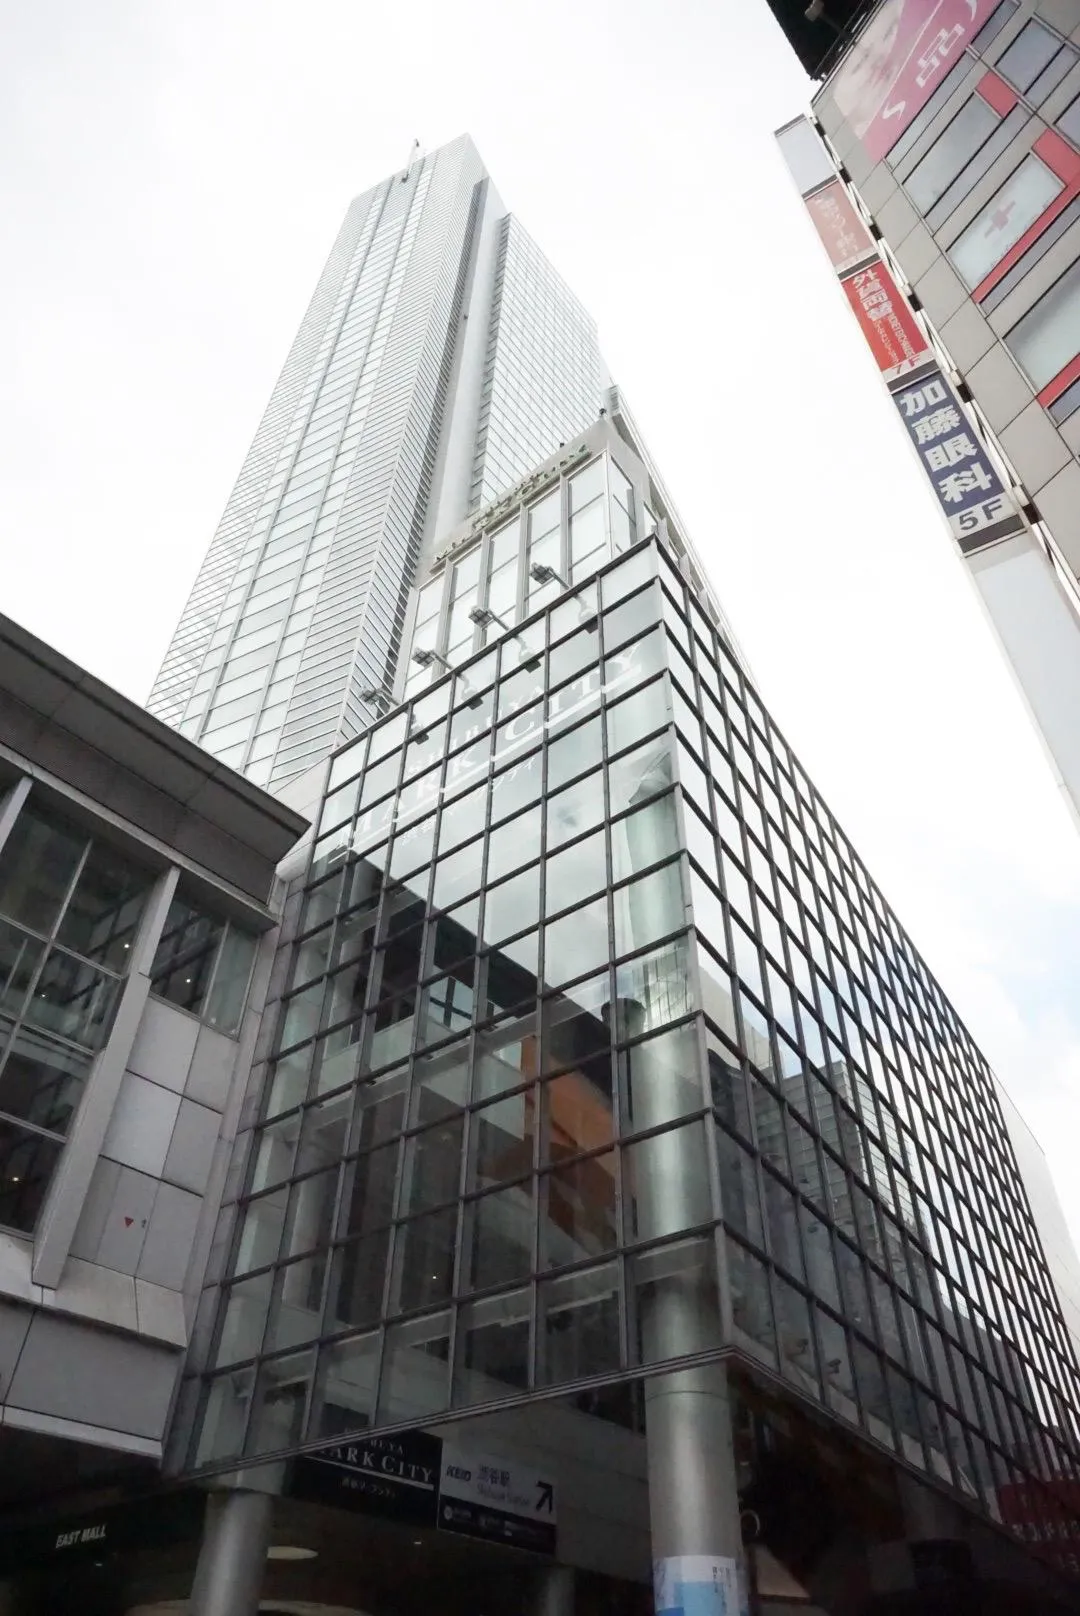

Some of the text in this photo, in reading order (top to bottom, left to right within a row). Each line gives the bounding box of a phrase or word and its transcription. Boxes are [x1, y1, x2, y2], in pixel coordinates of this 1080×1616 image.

[895, 354, 921, 374] 7F
[900, 379, 993, 503] 加藤眼科
[959, 498, 1003, 531] 5F
[505, 642, 641, 743] CITY
[381, 1455, 434, 1483] CITY
[55, 1523, 107, 1549] EAST MALL
